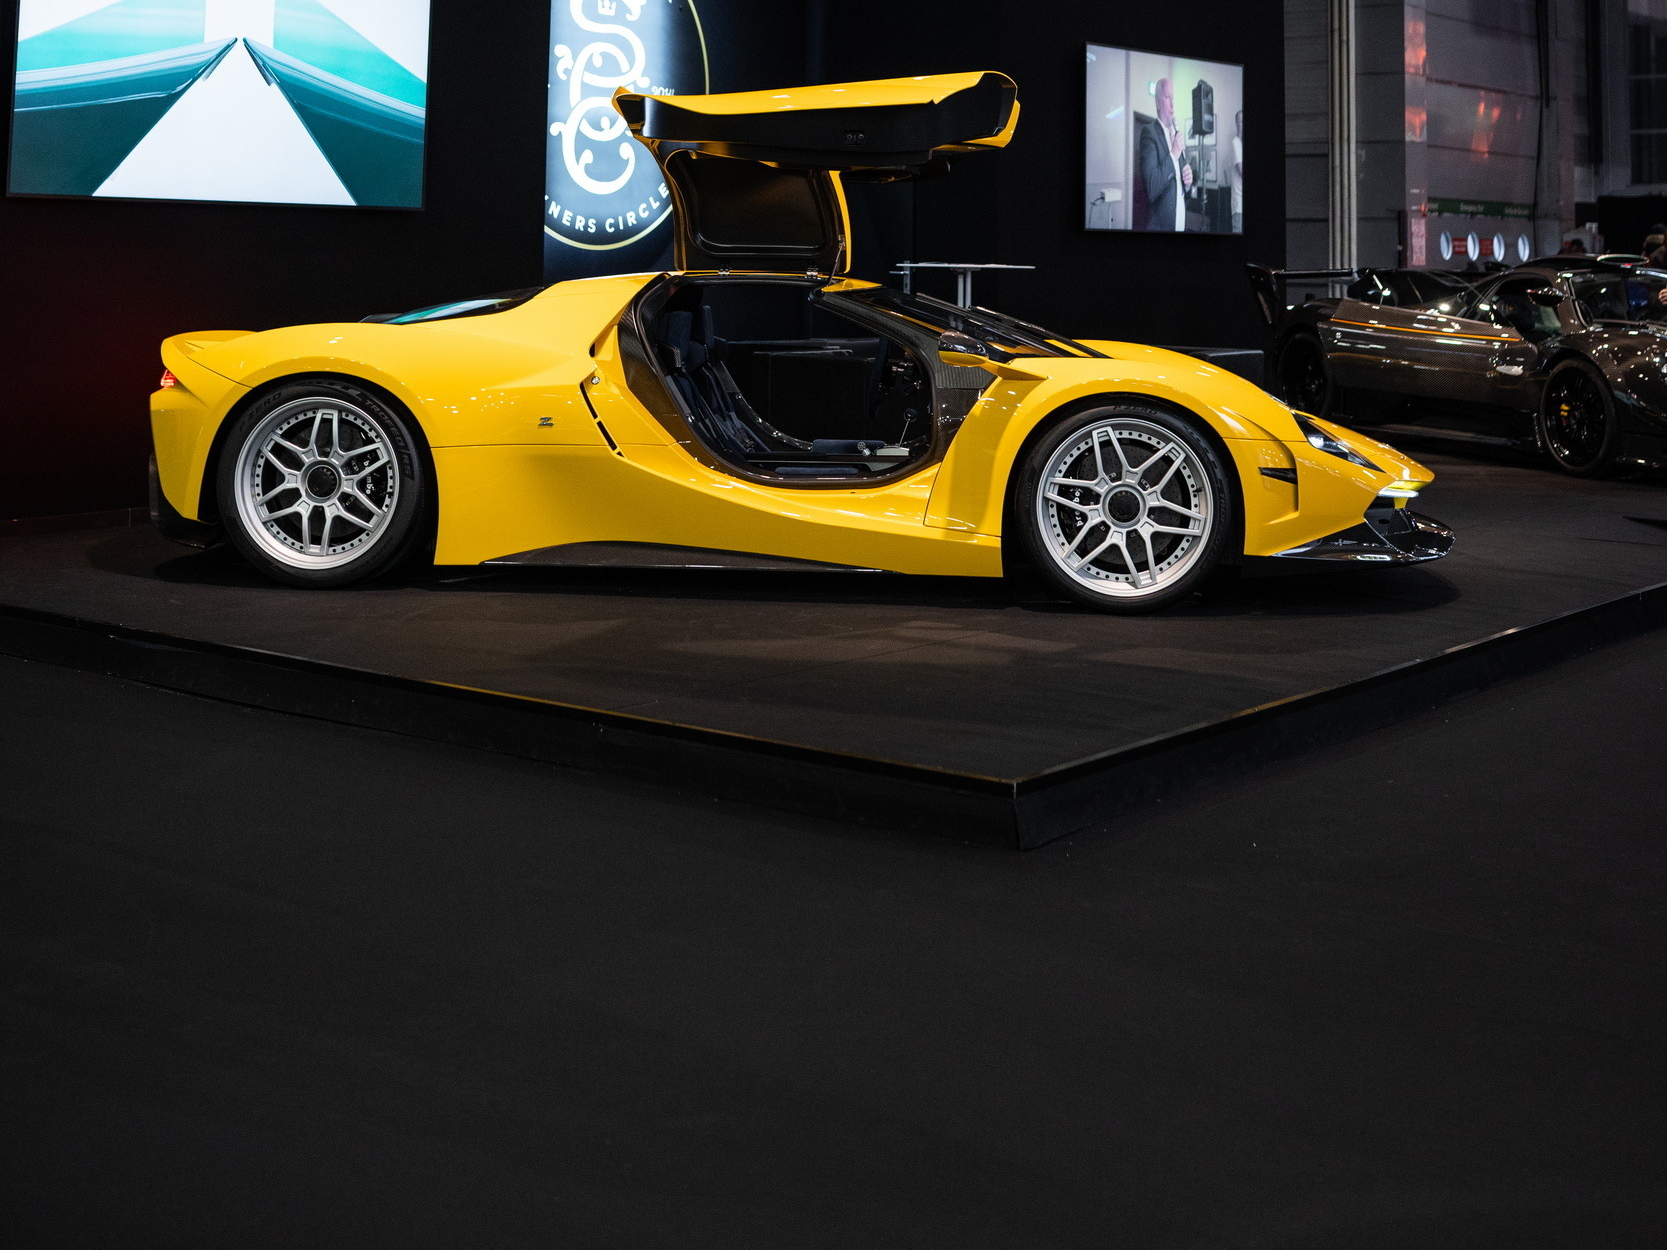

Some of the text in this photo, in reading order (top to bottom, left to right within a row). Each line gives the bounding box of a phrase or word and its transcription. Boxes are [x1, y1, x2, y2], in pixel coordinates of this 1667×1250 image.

[544, 182, 670, 234] NERS CIRCLE
[363, 460, 373, 495] bmbo
[1073, 491, 1084, 527] brebo
